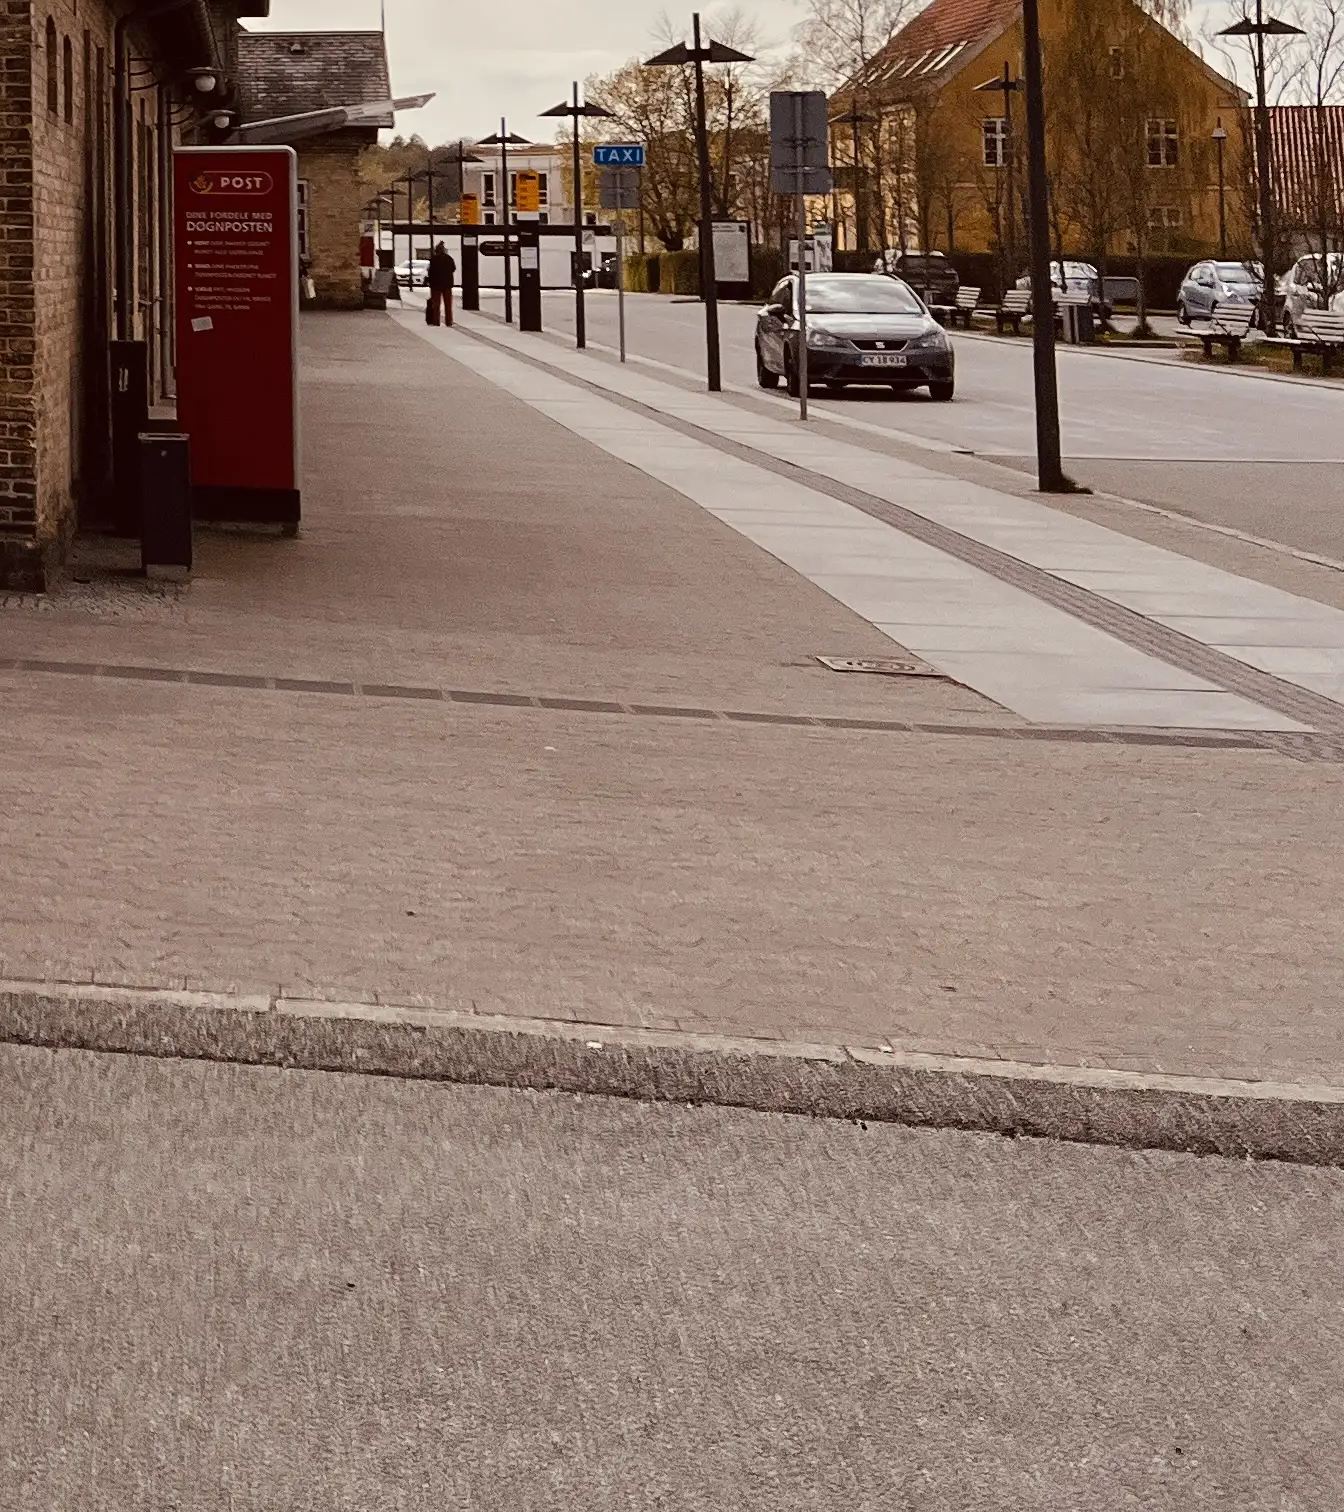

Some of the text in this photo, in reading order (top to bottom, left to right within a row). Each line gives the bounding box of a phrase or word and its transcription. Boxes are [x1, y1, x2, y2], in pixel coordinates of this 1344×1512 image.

[596, 148, 641, 162] TAXI
[220, 177, 263, 189] POST
[251, 211, 273, 220] MED
